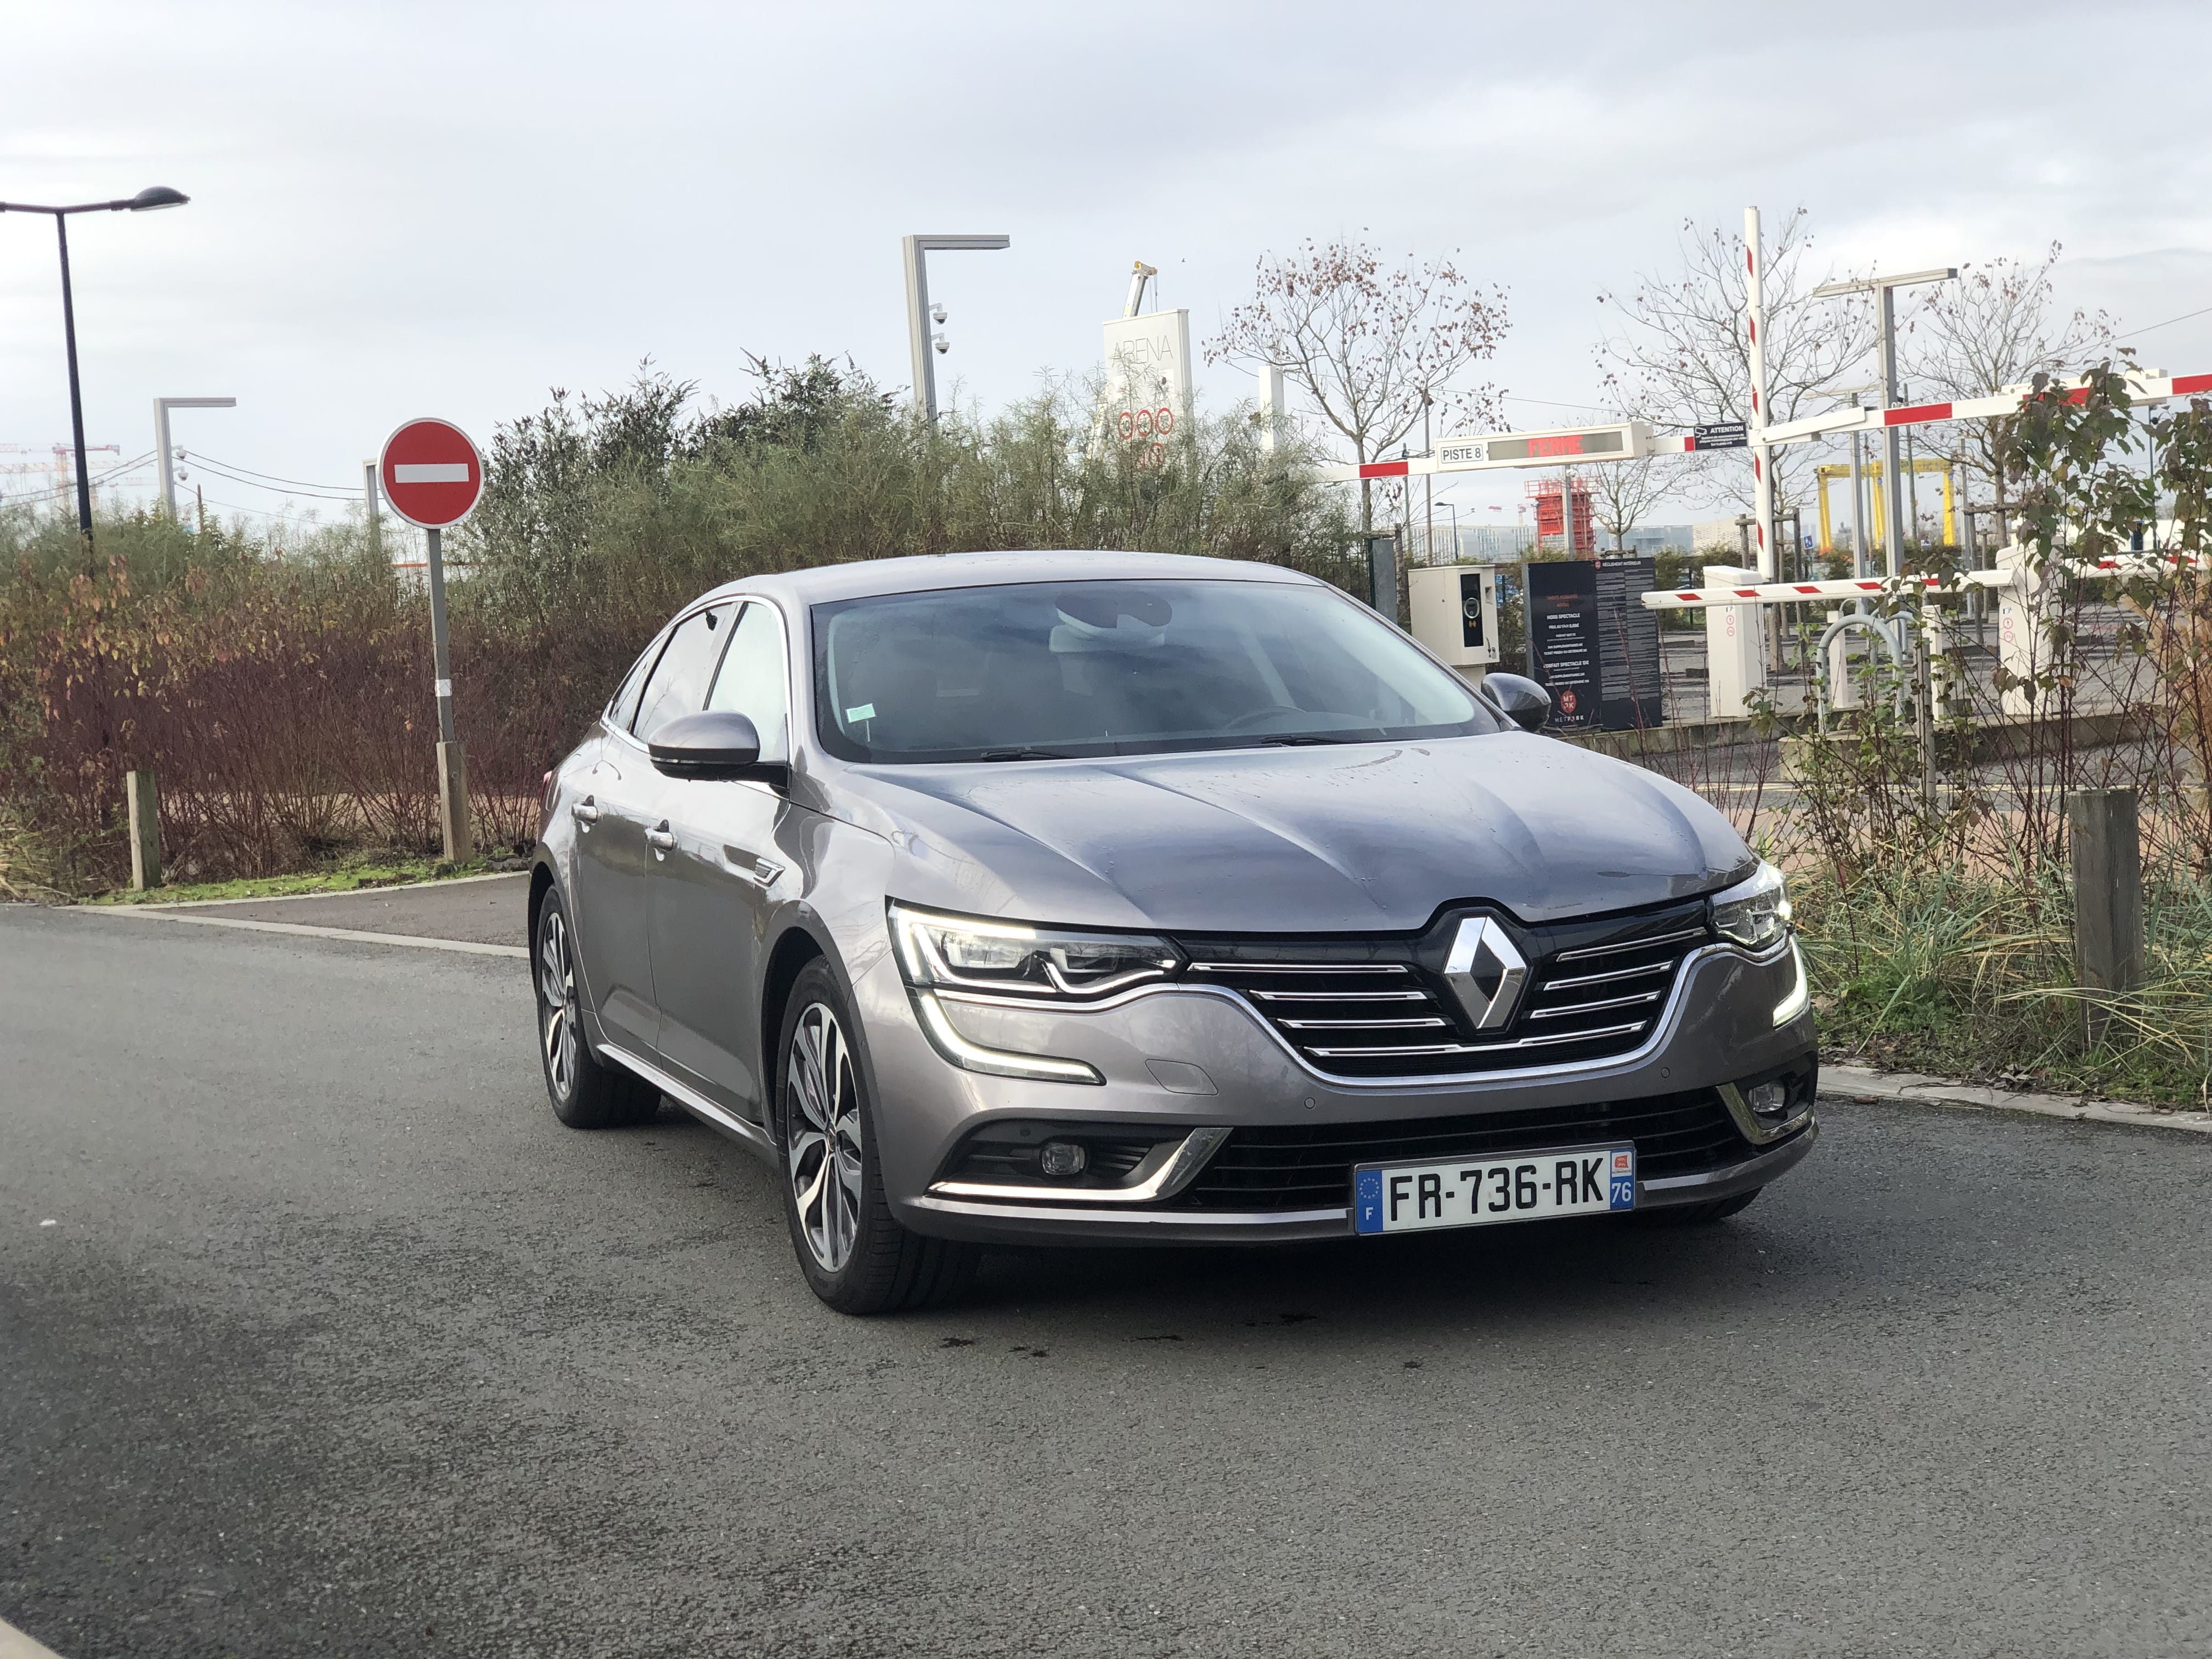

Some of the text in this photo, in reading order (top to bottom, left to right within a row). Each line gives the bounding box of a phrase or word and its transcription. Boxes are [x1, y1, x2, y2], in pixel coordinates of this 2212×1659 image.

[1111, 335, 1173, 368] ARENA
[1710, 425, 1743, 434] ATTENTION
[1443, 447, 1481, 461] PISTE 8
[1390, 1158, 1604, 1222] FR-736-RK
[1611, 1181, 1632, 1204] 76
[1365, 1206, 1374, 1221] F
